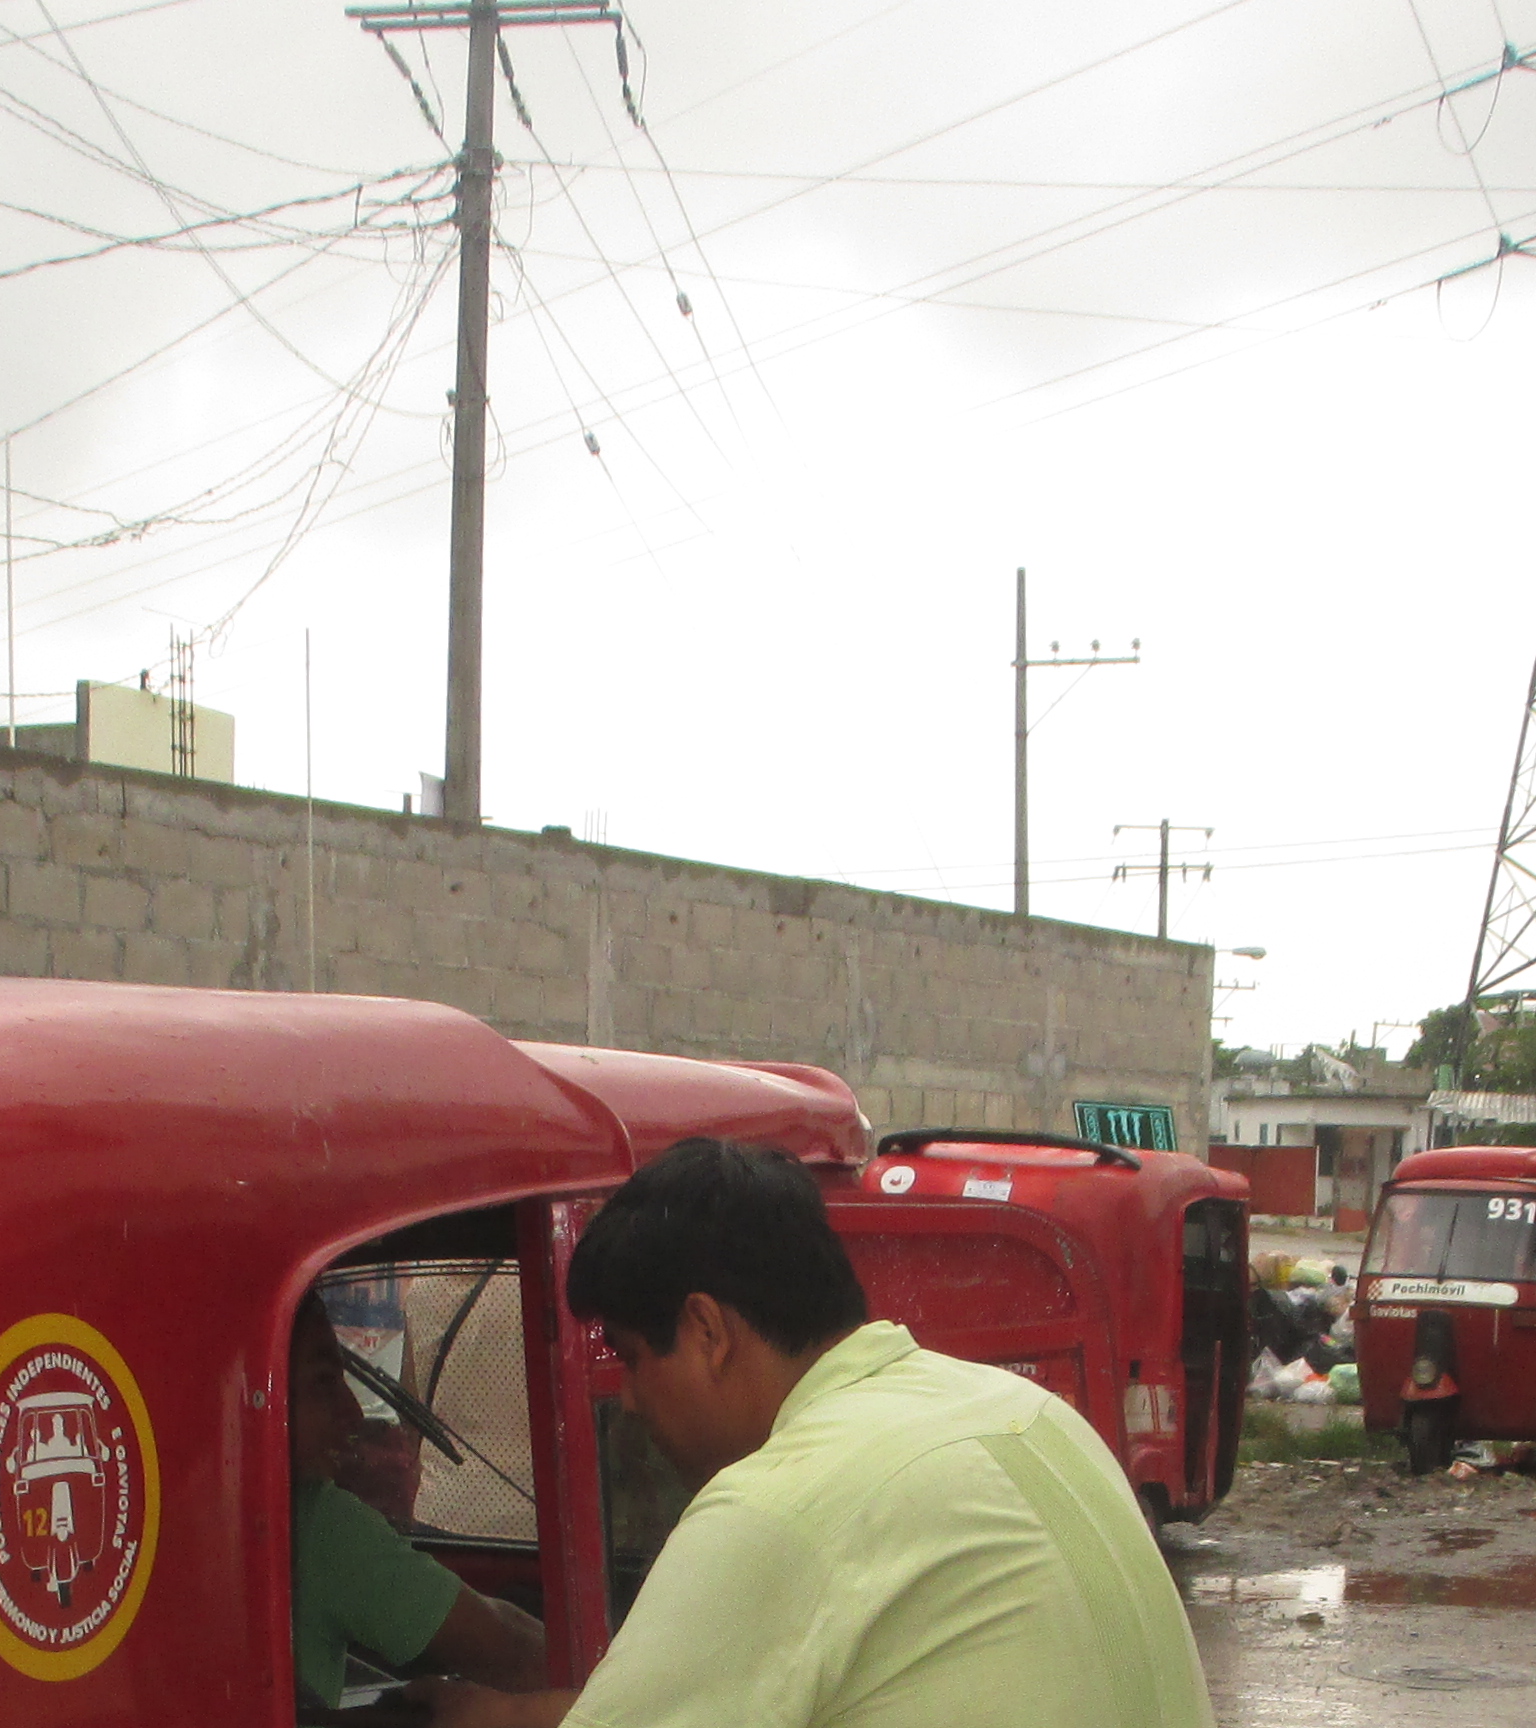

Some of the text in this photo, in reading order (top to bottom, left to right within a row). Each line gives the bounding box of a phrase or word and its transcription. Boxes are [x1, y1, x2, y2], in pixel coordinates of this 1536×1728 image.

[1391, 1281, 1466, 1297] Pochimóvil
[5, 1352, 112, 1411] INDEPENDIENTES
[22, 1507, 48, 1538] 12
[47, 1628, 58, 1644] Y
[59, 1599, 111, 1643] JUSTICIA
[107, 1539, 138, 1603] SOCIAL
